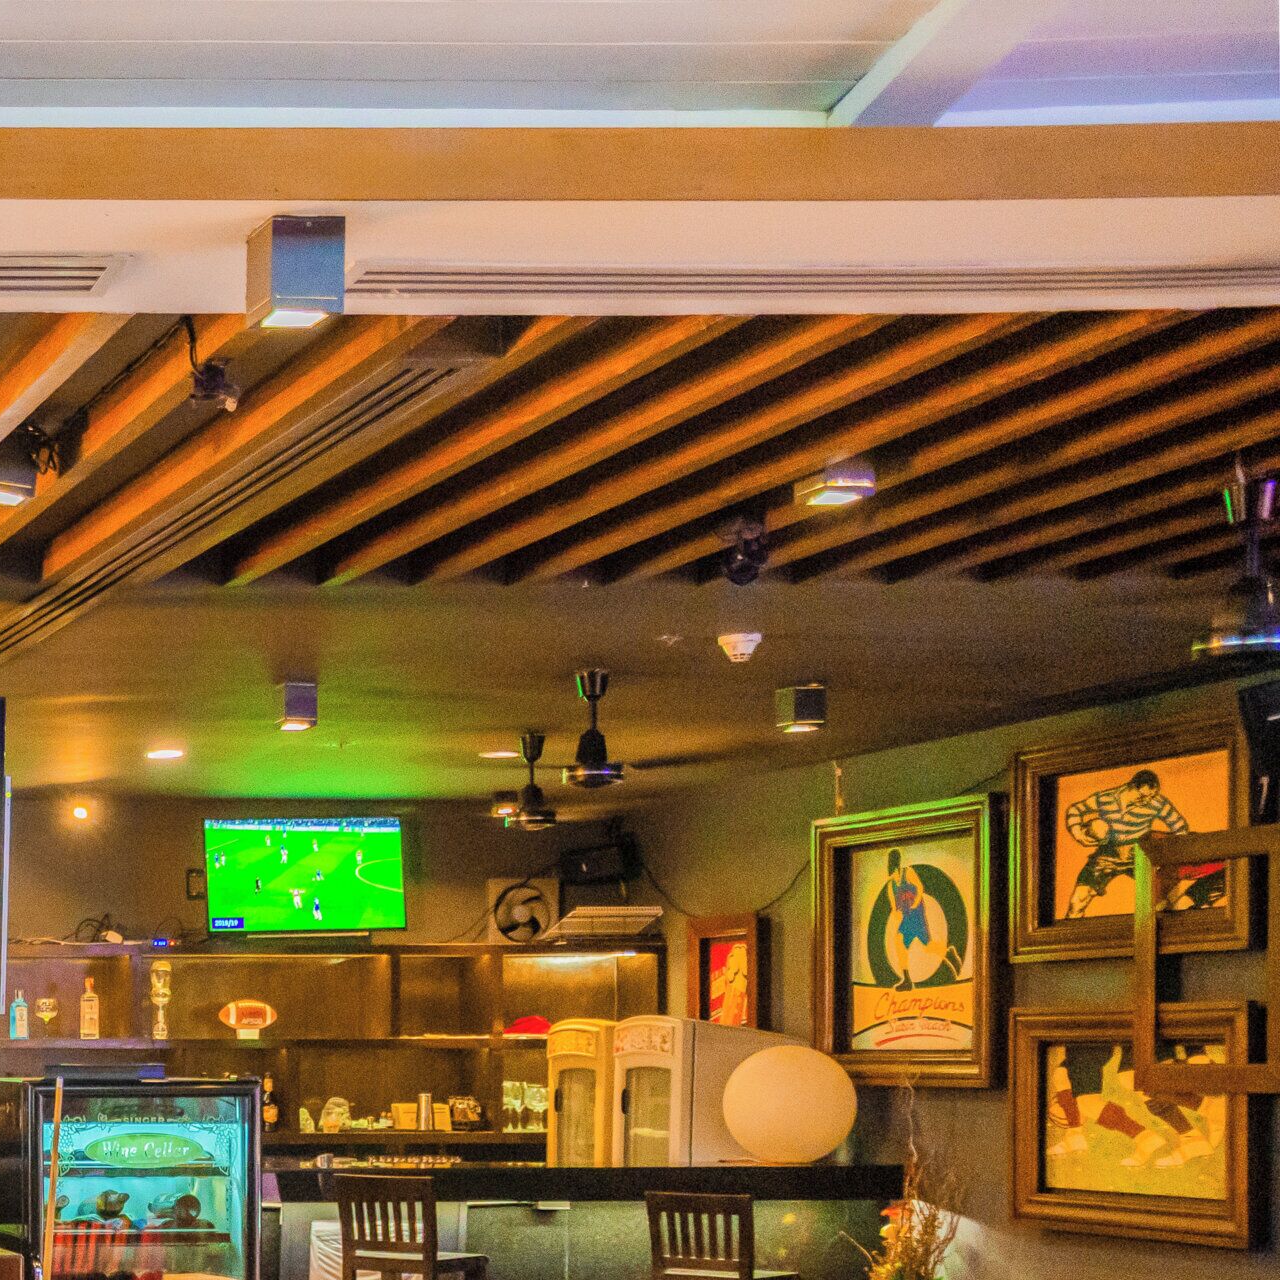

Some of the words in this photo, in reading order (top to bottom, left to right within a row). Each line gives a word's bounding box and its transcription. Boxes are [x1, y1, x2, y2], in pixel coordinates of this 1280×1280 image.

[874, 991, 965, 1020] Champions
[102, 1141, 137, 1158] Wine
[144, 1141, 190, 1158] Cellar
